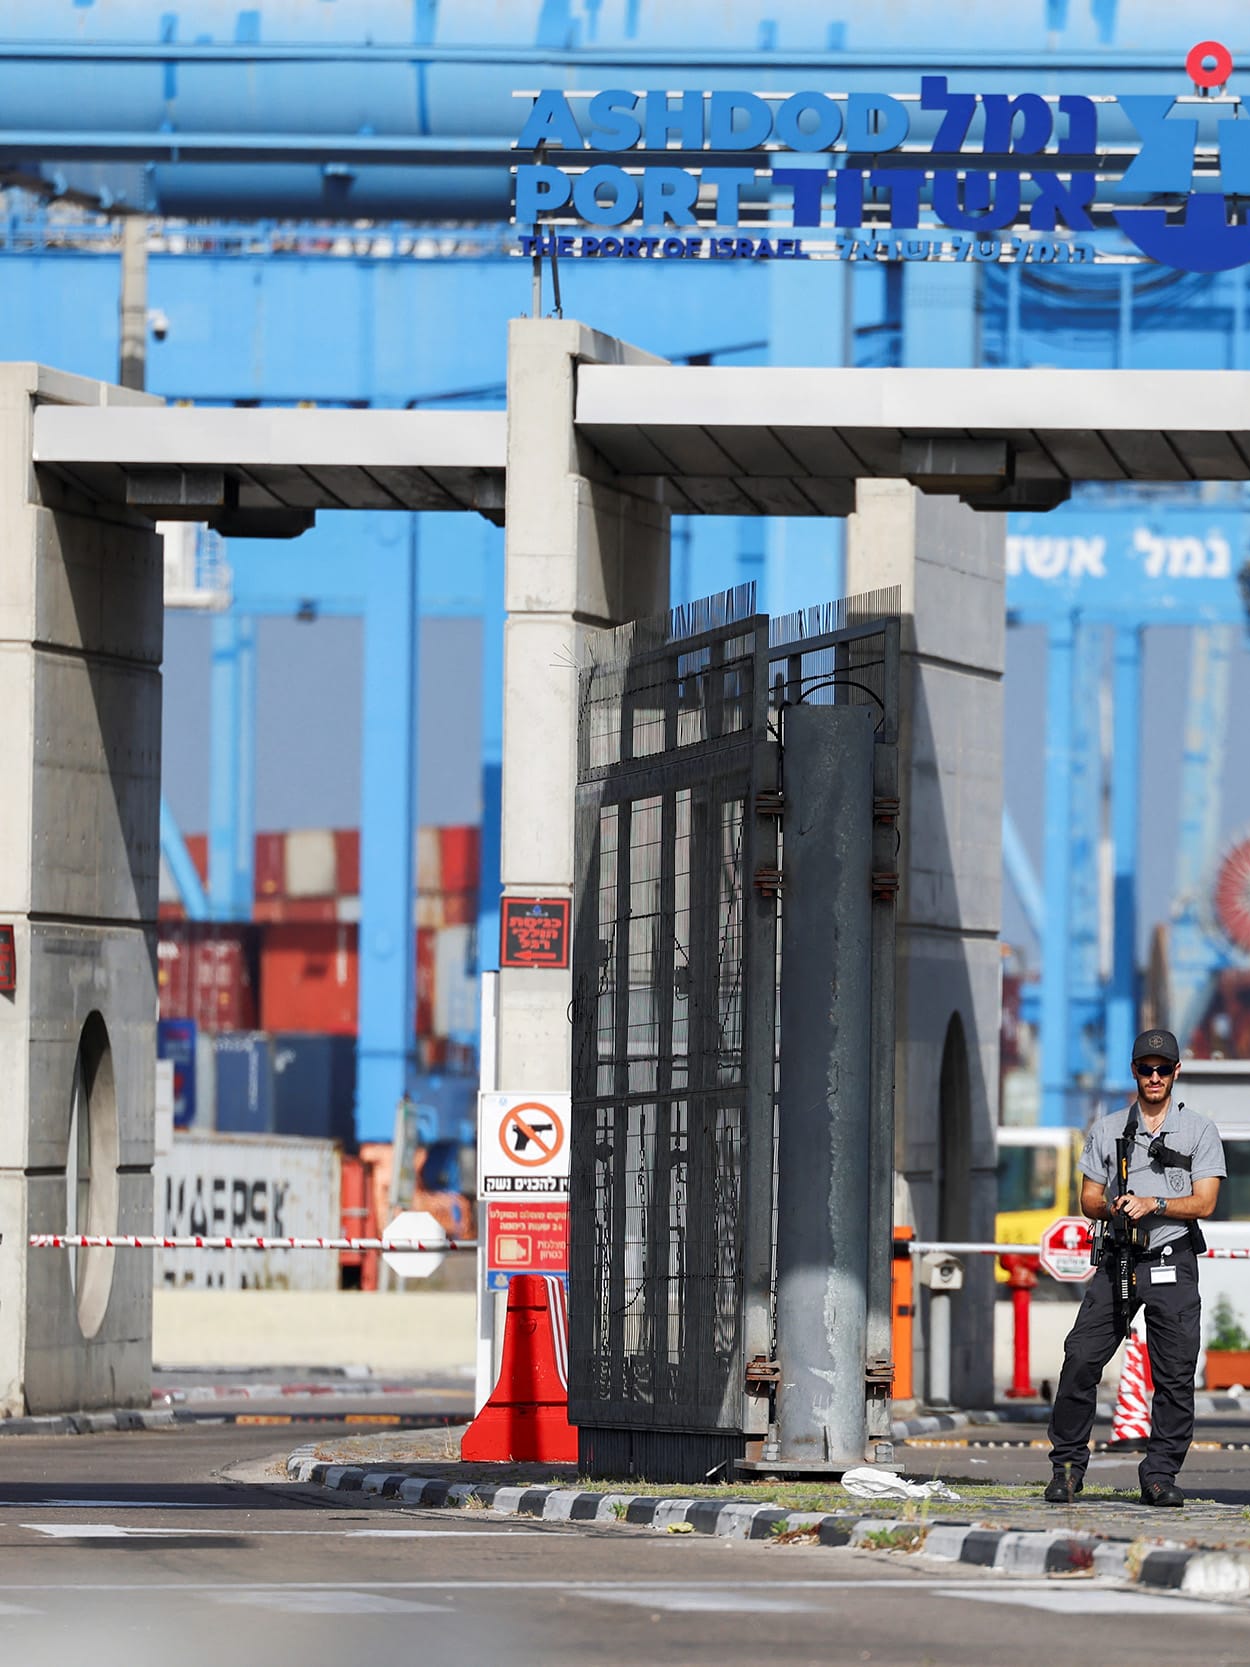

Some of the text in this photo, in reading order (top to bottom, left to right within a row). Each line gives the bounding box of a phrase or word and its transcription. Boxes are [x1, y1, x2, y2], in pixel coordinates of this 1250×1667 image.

[517, 89, 910, 152] ASHDOD
[921, 75, 1098, 154] נמל
[514, 164, 754, 227] PORT
[771, 167, 1098, 231] אשדוד
[518, 236, 808, 259] THE PORT OF ISRAEL
[836, 235, 1094, 263] הנמל של ישראל
[1133, 526, 1231, 577] נמל
[486, 1178, 511, 1192] נשק
[514, 1176, 556, 1191] להכניס
